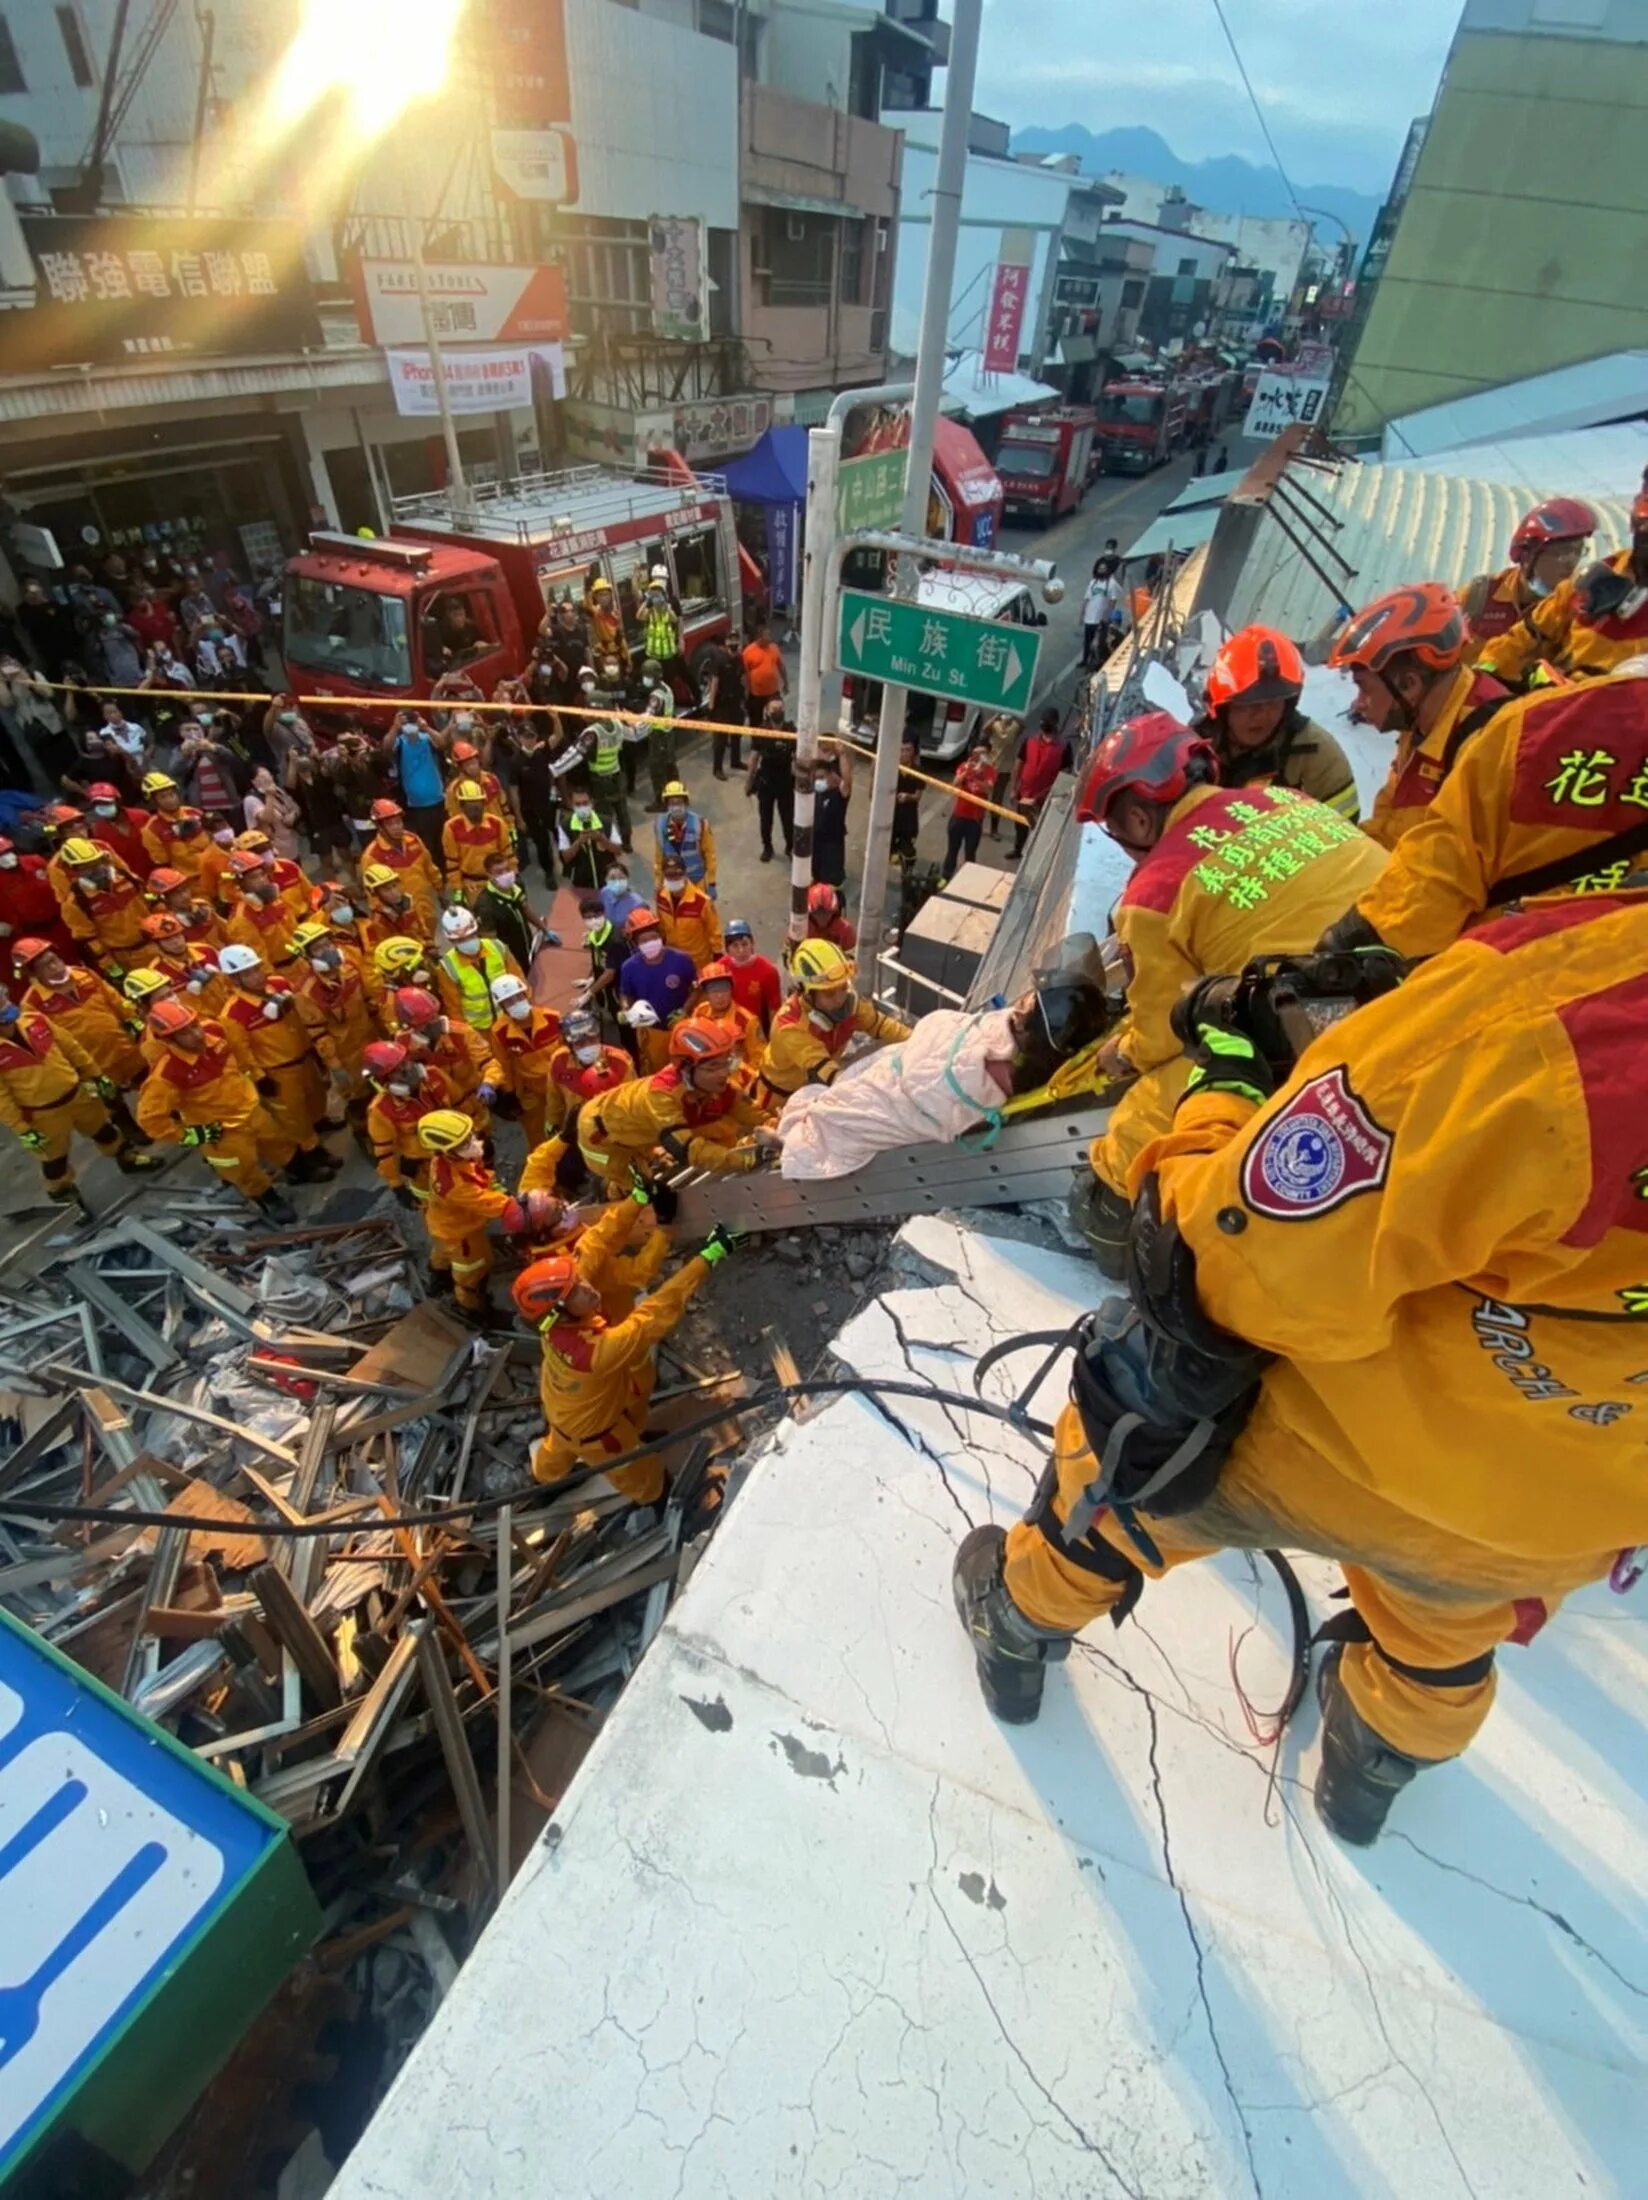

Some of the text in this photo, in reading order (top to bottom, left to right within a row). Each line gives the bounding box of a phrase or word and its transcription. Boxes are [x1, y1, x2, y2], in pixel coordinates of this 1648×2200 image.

[39, 250, 278, 303] 聯強電信聯盟
[866, 607, 1007, 673] 民族街
[890, 655, 968, 688] Min Zu St.
[1472, 1298, 1582, 1400] ARCH
